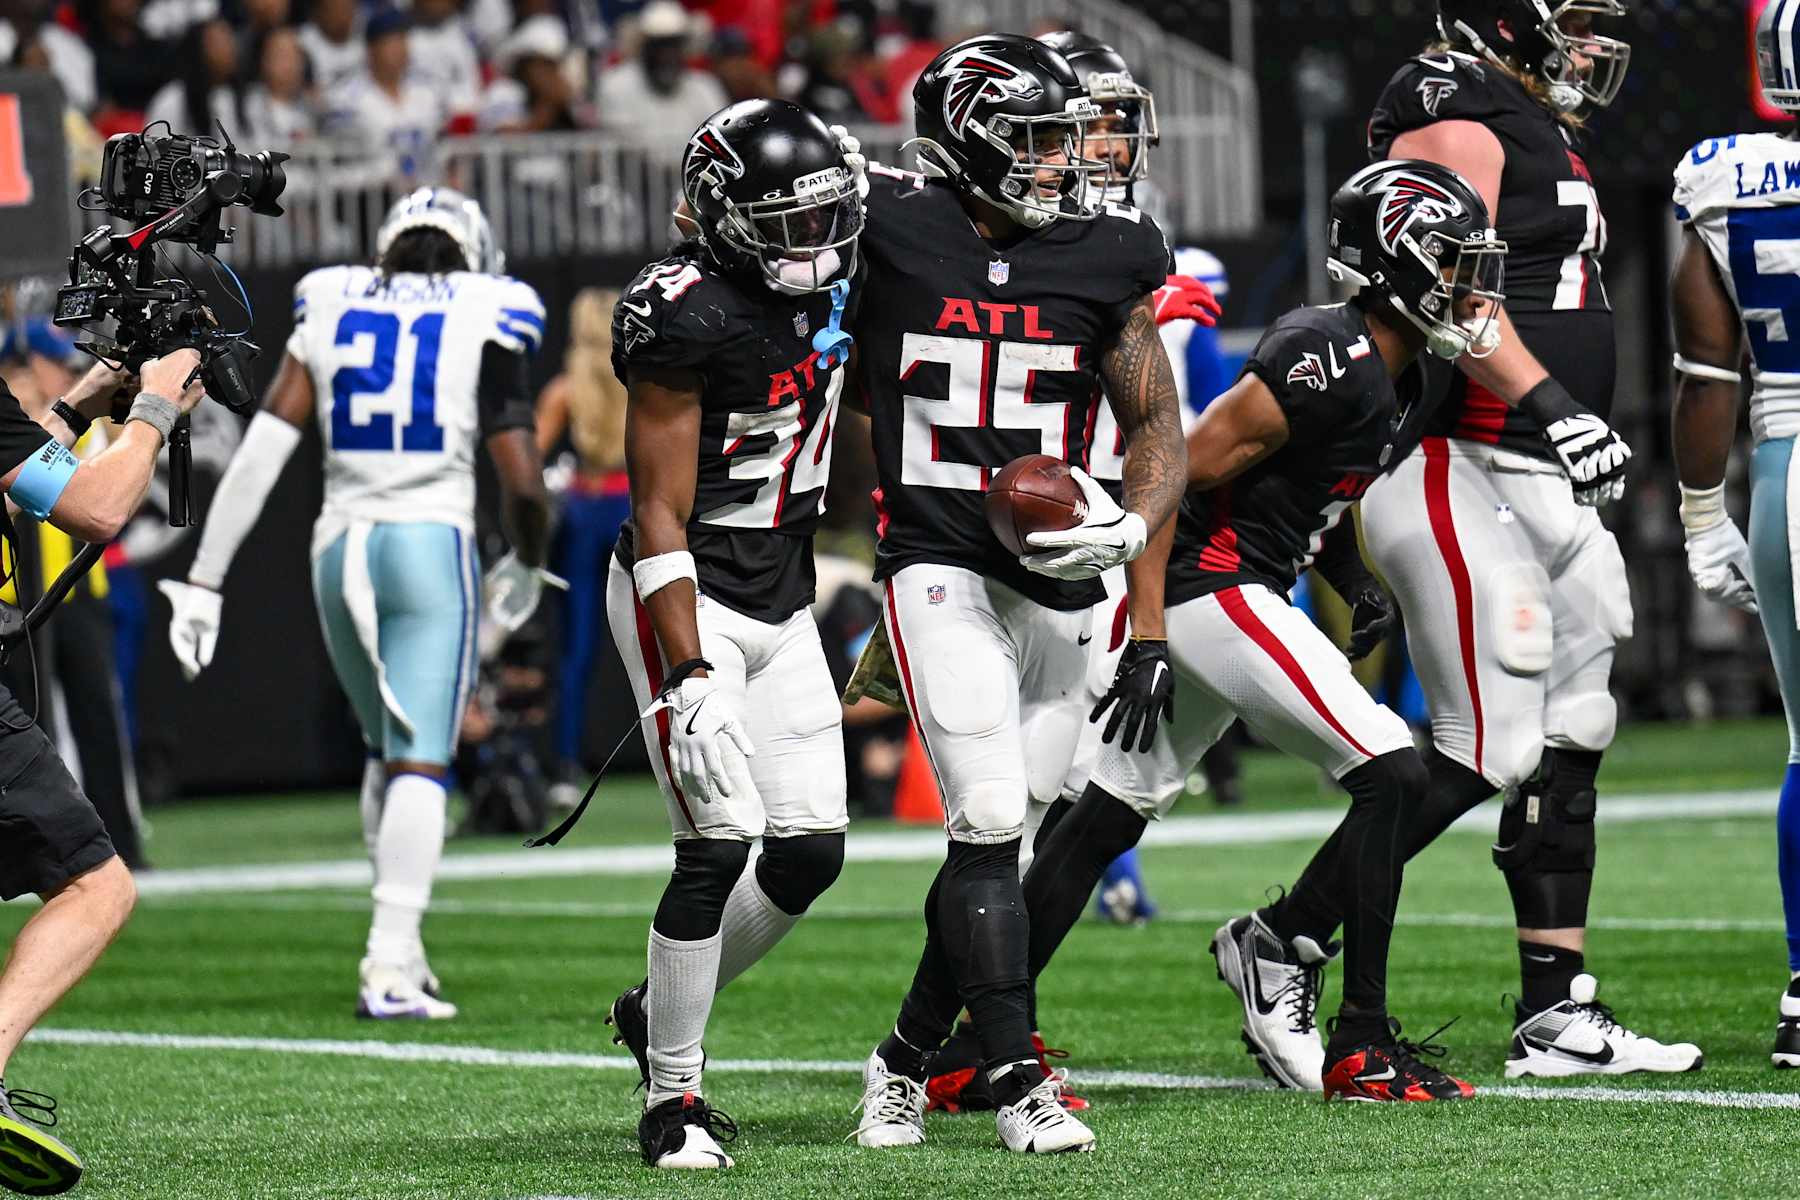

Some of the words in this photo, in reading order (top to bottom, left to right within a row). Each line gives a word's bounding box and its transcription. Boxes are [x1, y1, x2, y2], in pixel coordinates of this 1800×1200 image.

[143, 172, 154, 195] CVP
[809, 174, 832, 188] ATL
[935, 296, 1054, 339] ATL
[331, 308, 446, 452] 21
[768, 350, 836, 407] AT
[900, 332, 1081, 491] 25
[698, 362, 845, 528] 34
